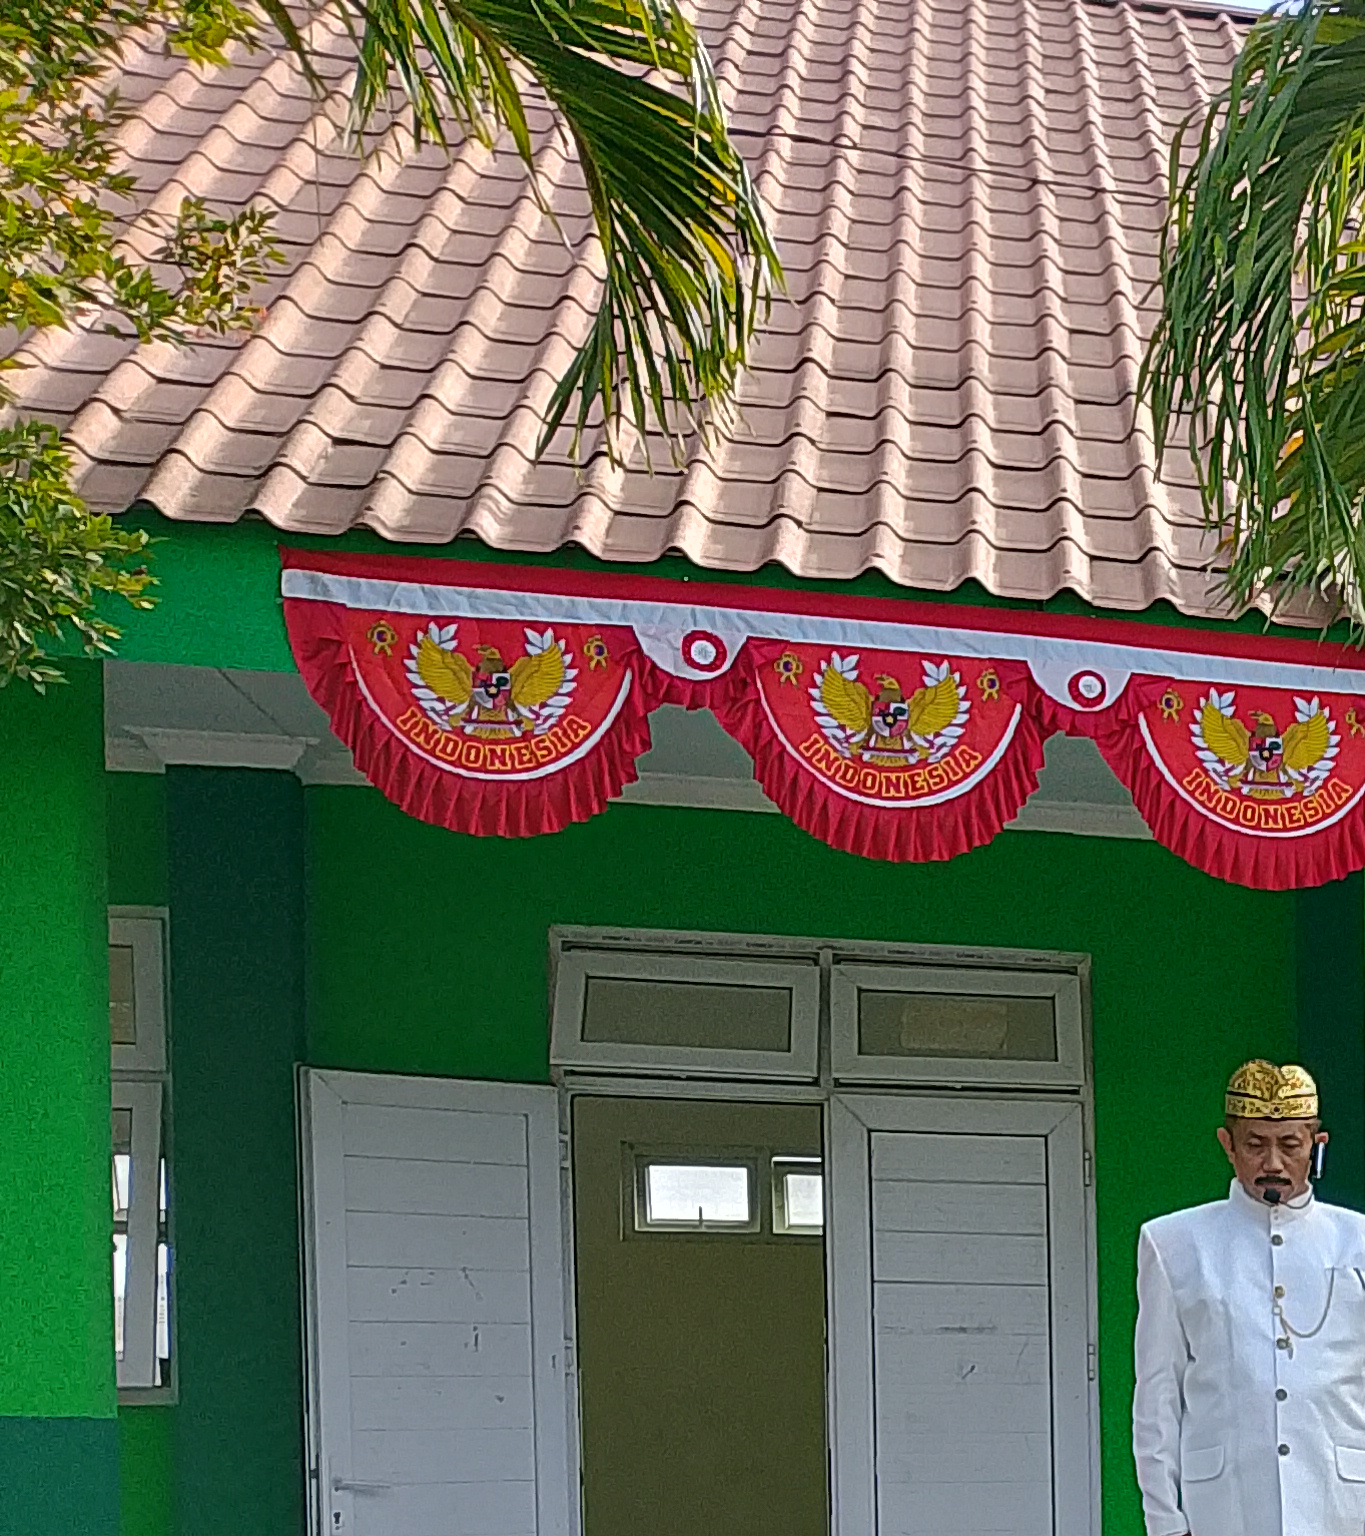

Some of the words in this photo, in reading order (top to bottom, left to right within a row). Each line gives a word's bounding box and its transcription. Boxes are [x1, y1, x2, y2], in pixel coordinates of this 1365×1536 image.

[397, 707, 591, 770] INDONESIA
[800, 733, 982, 797] INDONESIA
[1183, 768, 1353, 829] INDONESIA
